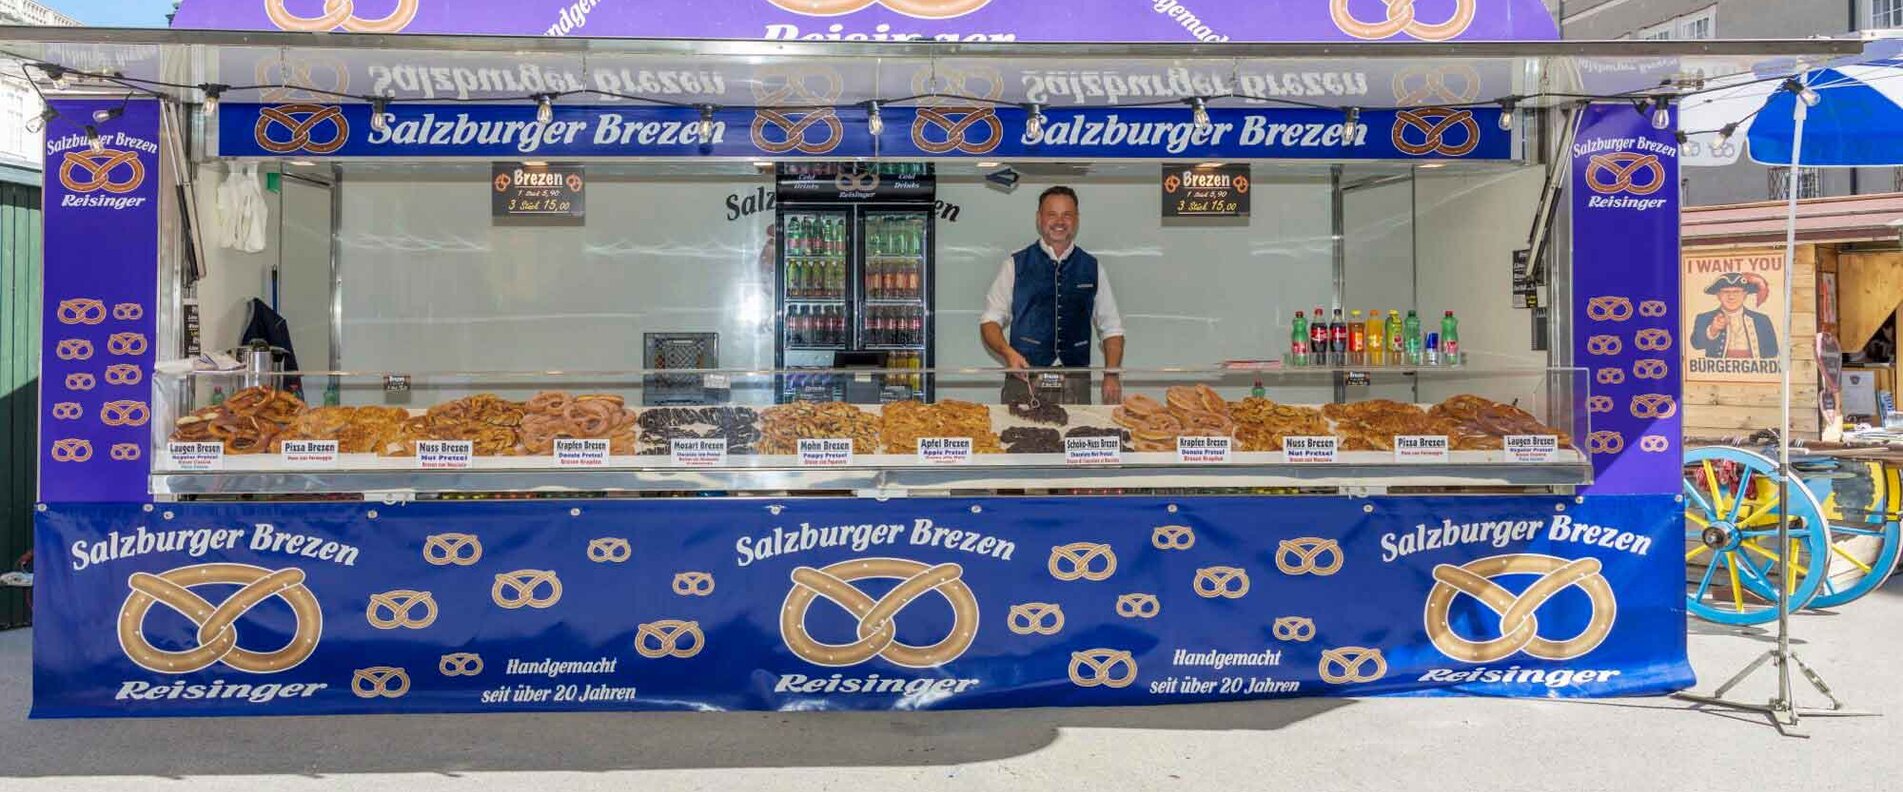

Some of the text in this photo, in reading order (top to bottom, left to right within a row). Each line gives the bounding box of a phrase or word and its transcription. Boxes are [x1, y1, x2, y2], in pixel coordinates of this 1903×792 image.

[367, 112, 726, 153] Salzburger Brezen
[1021, 113, 1368, 154] Salzburger Brezen
[47, 131, 159, 156] Salzbuer Brezen
[1573, 136, 1678, 158] Salzburger Brezen
[514, 168, 563, 185] Brezen
[1183, 170, 1230, 187] Brezen
[61, 194, 146, 210] Reisinger
[508, 199, 516, 210] 3
[544, 199, 570, 211] 15,00
[1177, 200, 1186, 211] 3
[1211, 200, 1237, 213] 15,00
[1588, 195, 1667, 211] Reisinger
[1687, 257, 1782, 273] I WANT YOU
[1689, 357, 1782, 373] BÜRGERGARD
[170, 443, 221, 454] Laugen Brezen
[284, 442, 335, 452] Pizza Brezen
[419, 442, 469, 452] Nuss Brezen
[556, 441, 606, 451] Krapfen Brezen
[674, 440, 724, 450] Mozart Brezen
[800, 441, 850, 450] Mohn Brezen
[920, 439, 970, 449] Apfel Brezen
[1067, 439, 1118, 449] Schoko-Nuss Brezen
[1179, 438, 1228, 448] Krapfen Brezen
[1286, 438, 1334, 448] Nuss Brezen
[1398, 438, 1446, 447] Pizza Brezen
[1507, 437, 1555, 448] Laugen Brezen
[736, 518, 1017, 567] Salzburger Brezen
[1380, 514, 1652, 563] Salzburger Brezen
[72, 523, 360, 571] Salzburger Brezen
[1173, 648, 1281, 670] Handgemacht
[506, 657, 617, 678] Handgemacht
[1419, 665, 1621, 688] Reisinger
[115, 679, 328, 703] Reisinger
[774, 673, 980, 697] Reisinger
[1149, 676, 1300, 696] seit über 20 Jahren
[481, 683, 636, 704] seit über 20 Jahren
